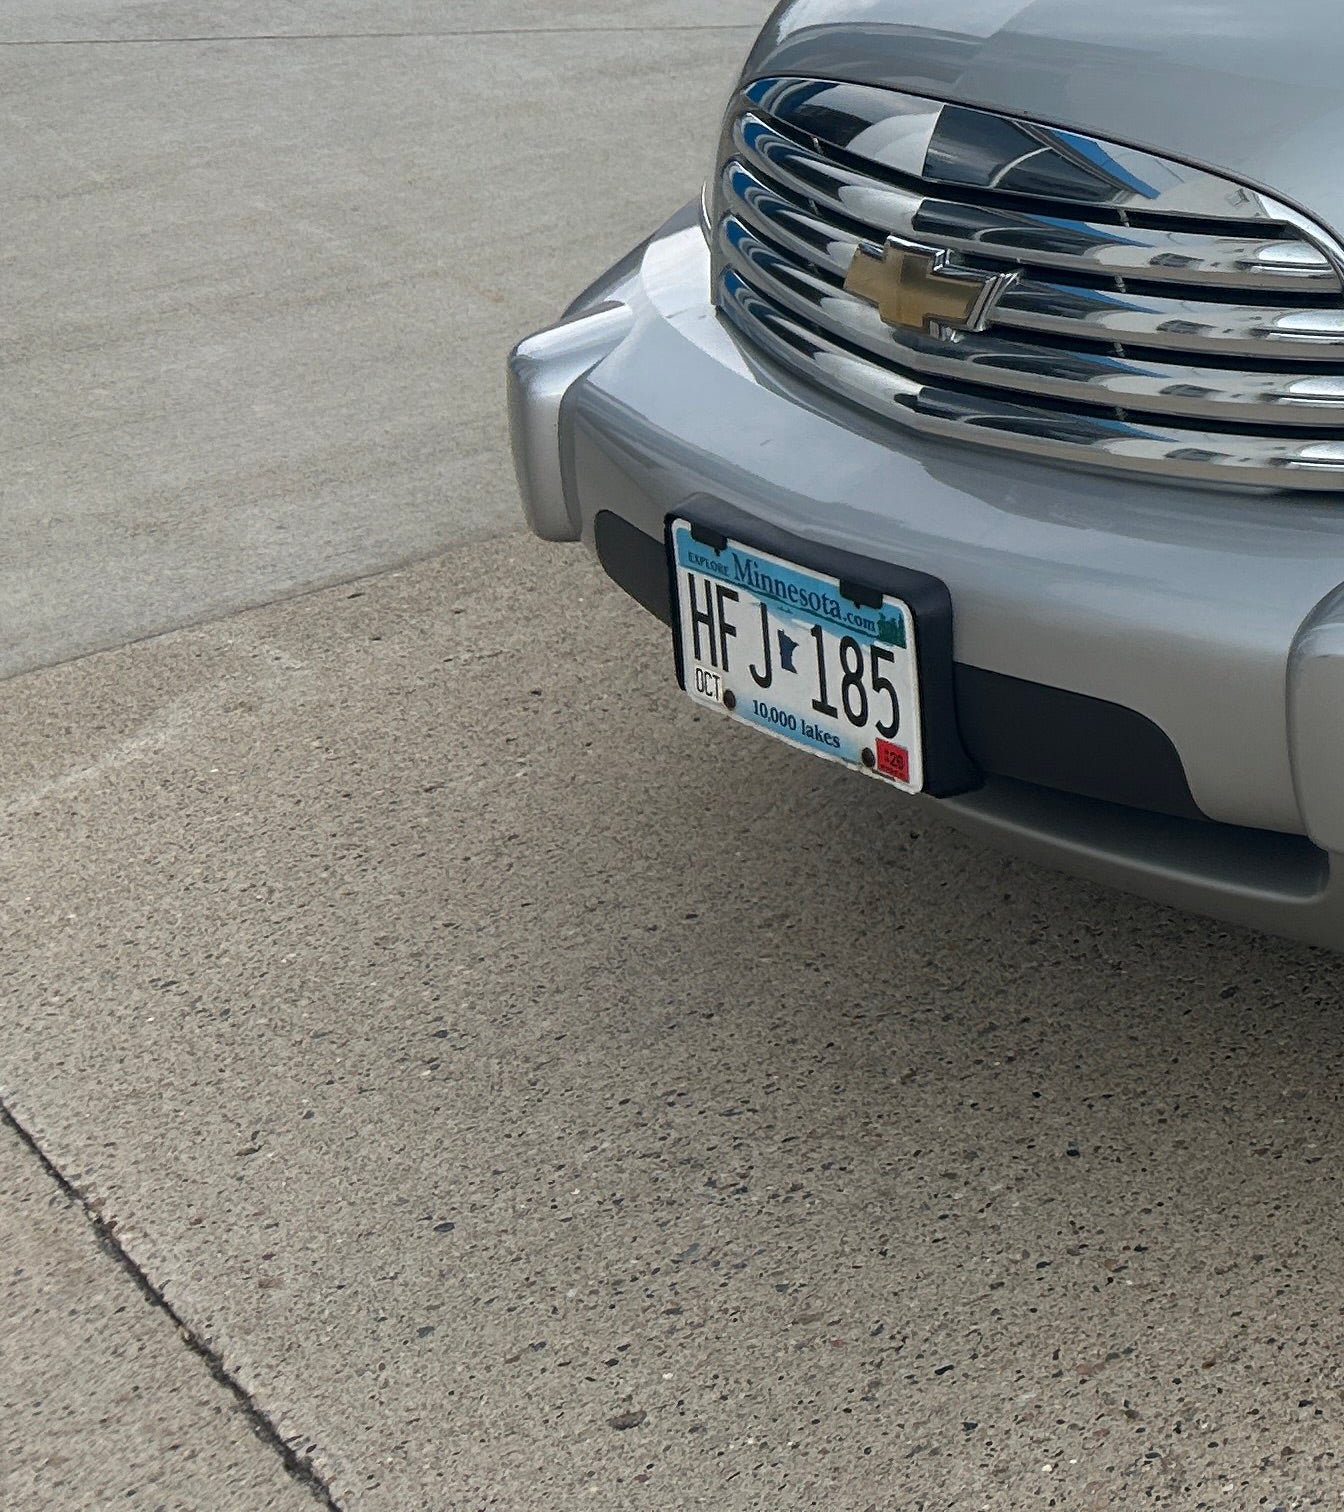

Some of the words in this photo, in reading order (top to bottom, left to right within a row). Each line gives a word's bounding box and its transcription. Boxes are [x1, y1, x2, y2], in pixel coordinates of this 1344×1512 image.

[688, 550, 730, 577] EXPLORE
[694, 667, 721, 701] OCT
[752, 699, 797, 731] 10,000
[799, 718, 842, 748] lakes
